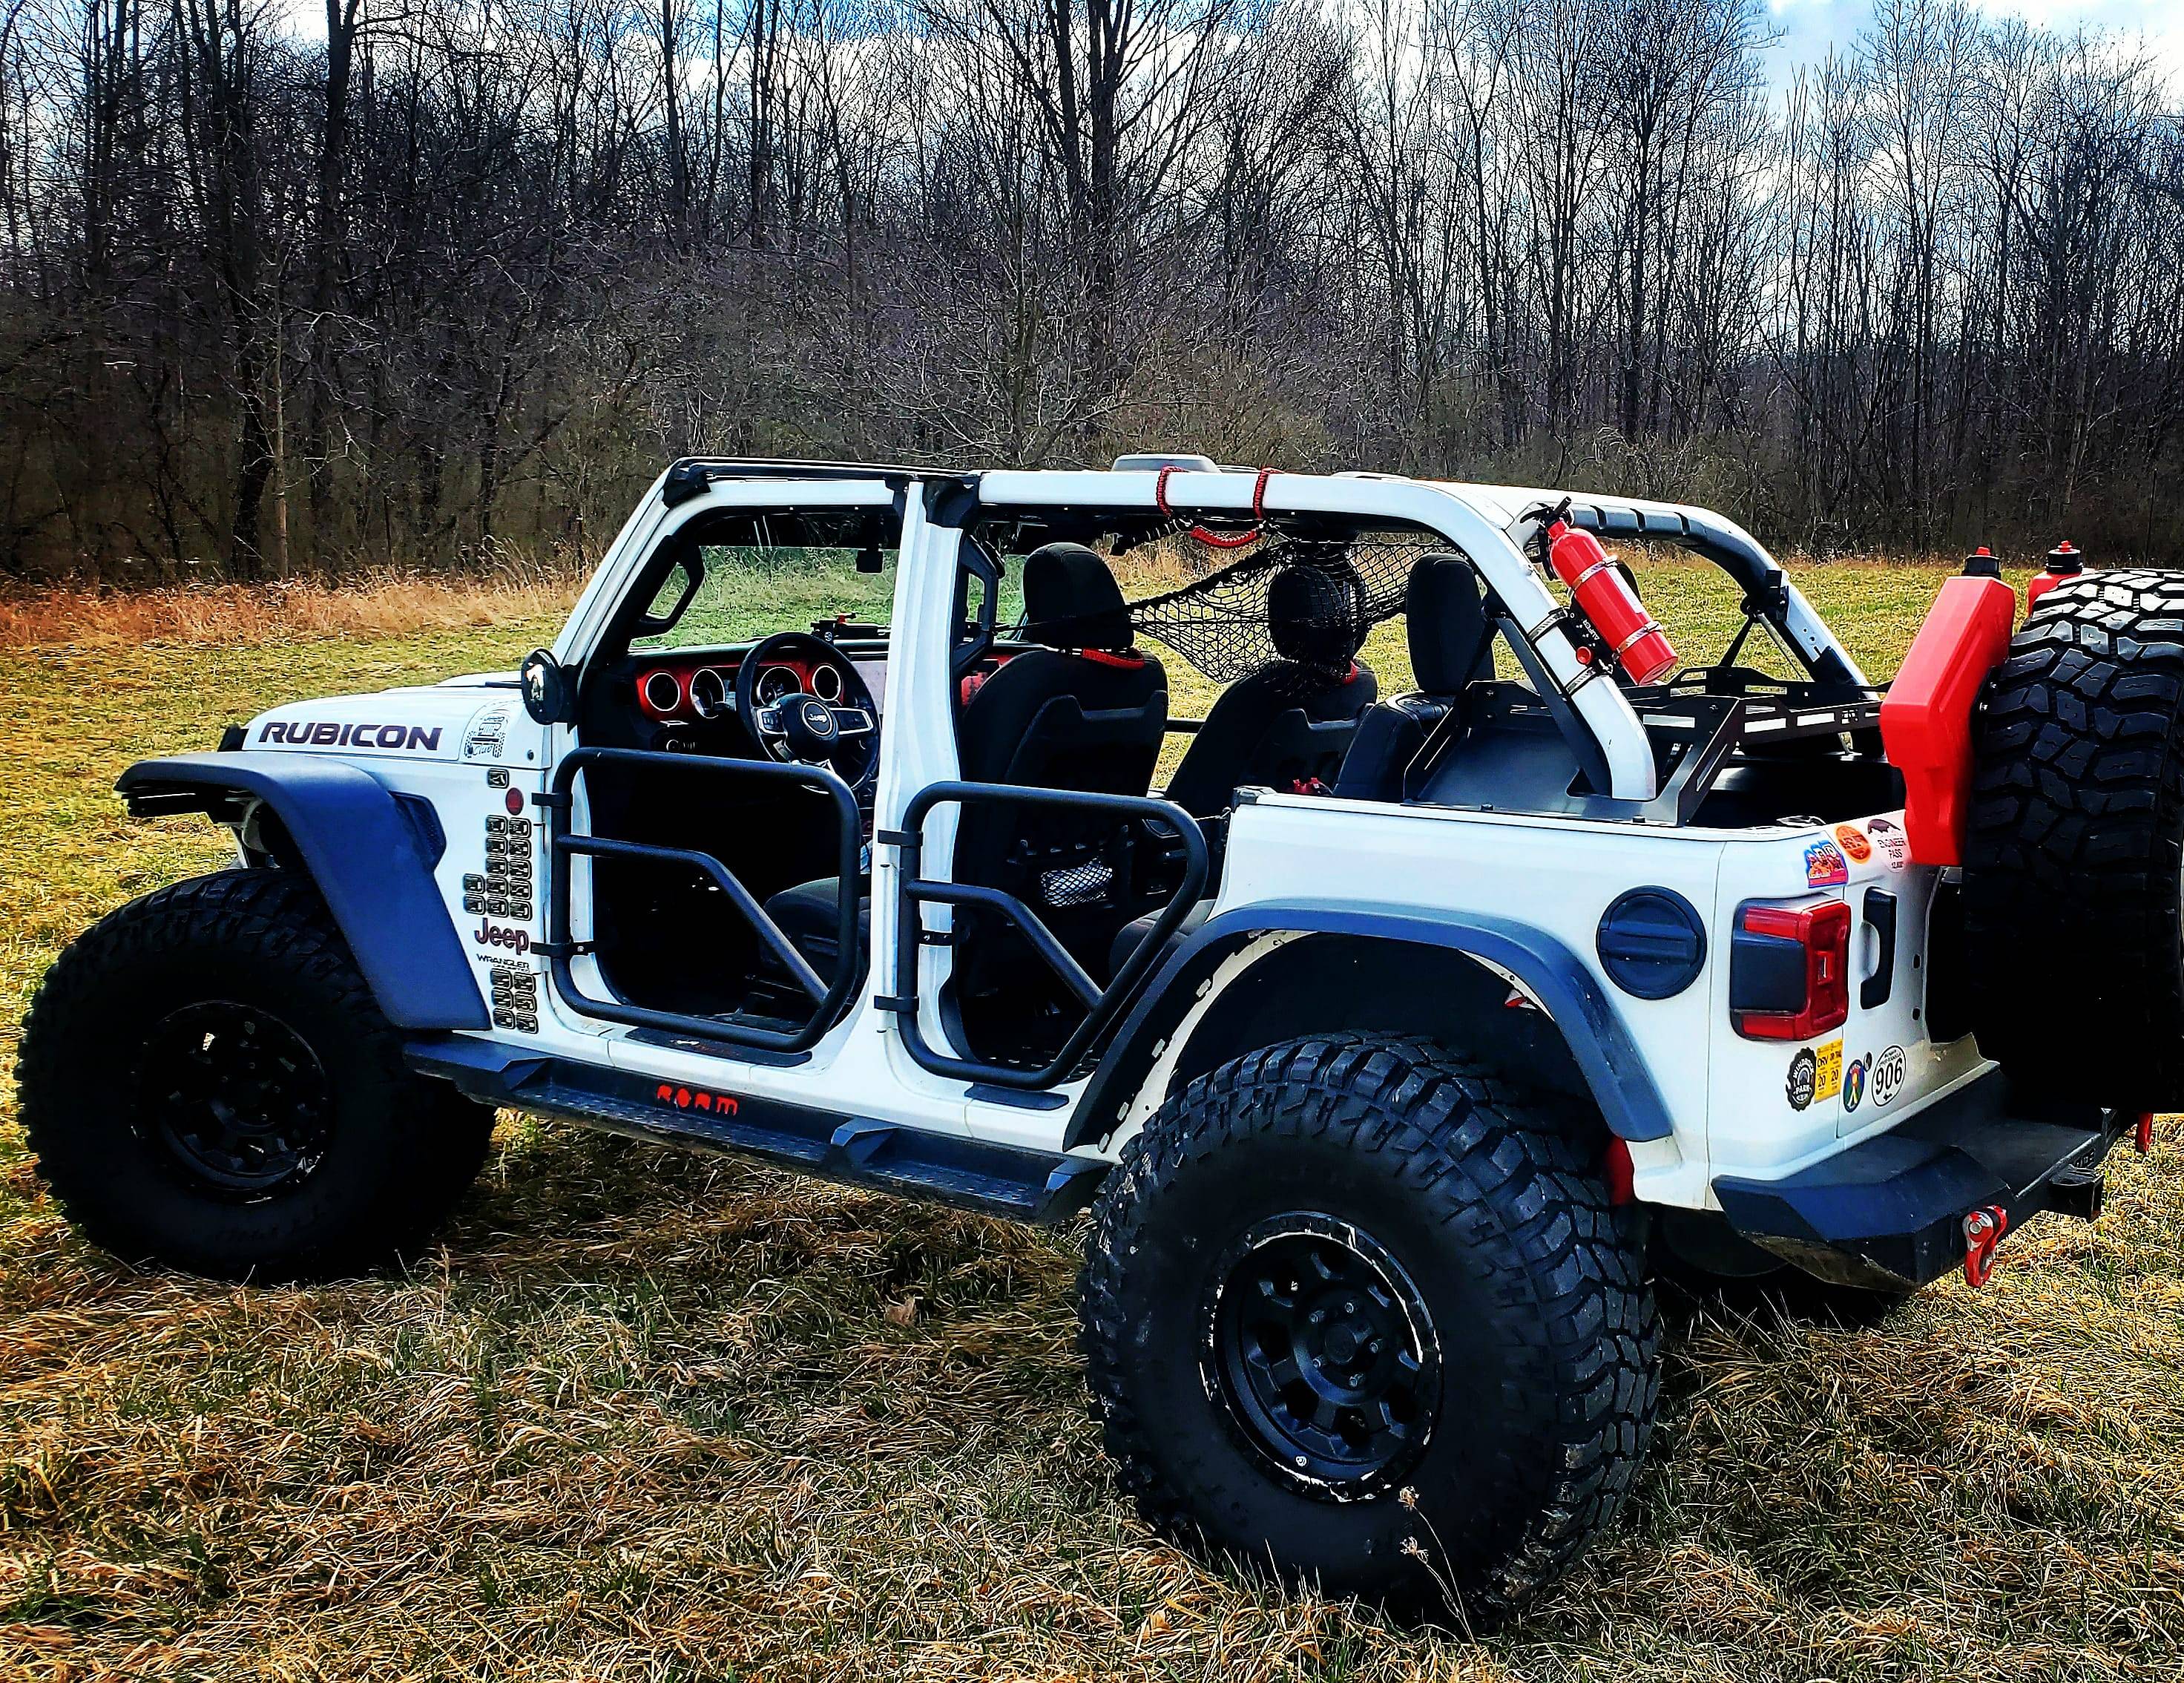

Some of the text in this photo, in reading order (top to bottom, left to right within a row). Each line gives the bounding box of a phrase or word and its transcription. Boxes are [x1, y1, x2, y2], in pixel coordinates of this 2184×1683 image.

[258, 722, 443, 750] RUBICON
[474, 917, 530, 956] Jeep
[476, 954, 530, 969] WRANGLER
[1818, 1075, 1826, 1088] 20
[1831, 1069, 1839, 1082] 20
[1875, 1057, 1903, 1095] 906
[1795, 1084, 1811, 1095] PARK
